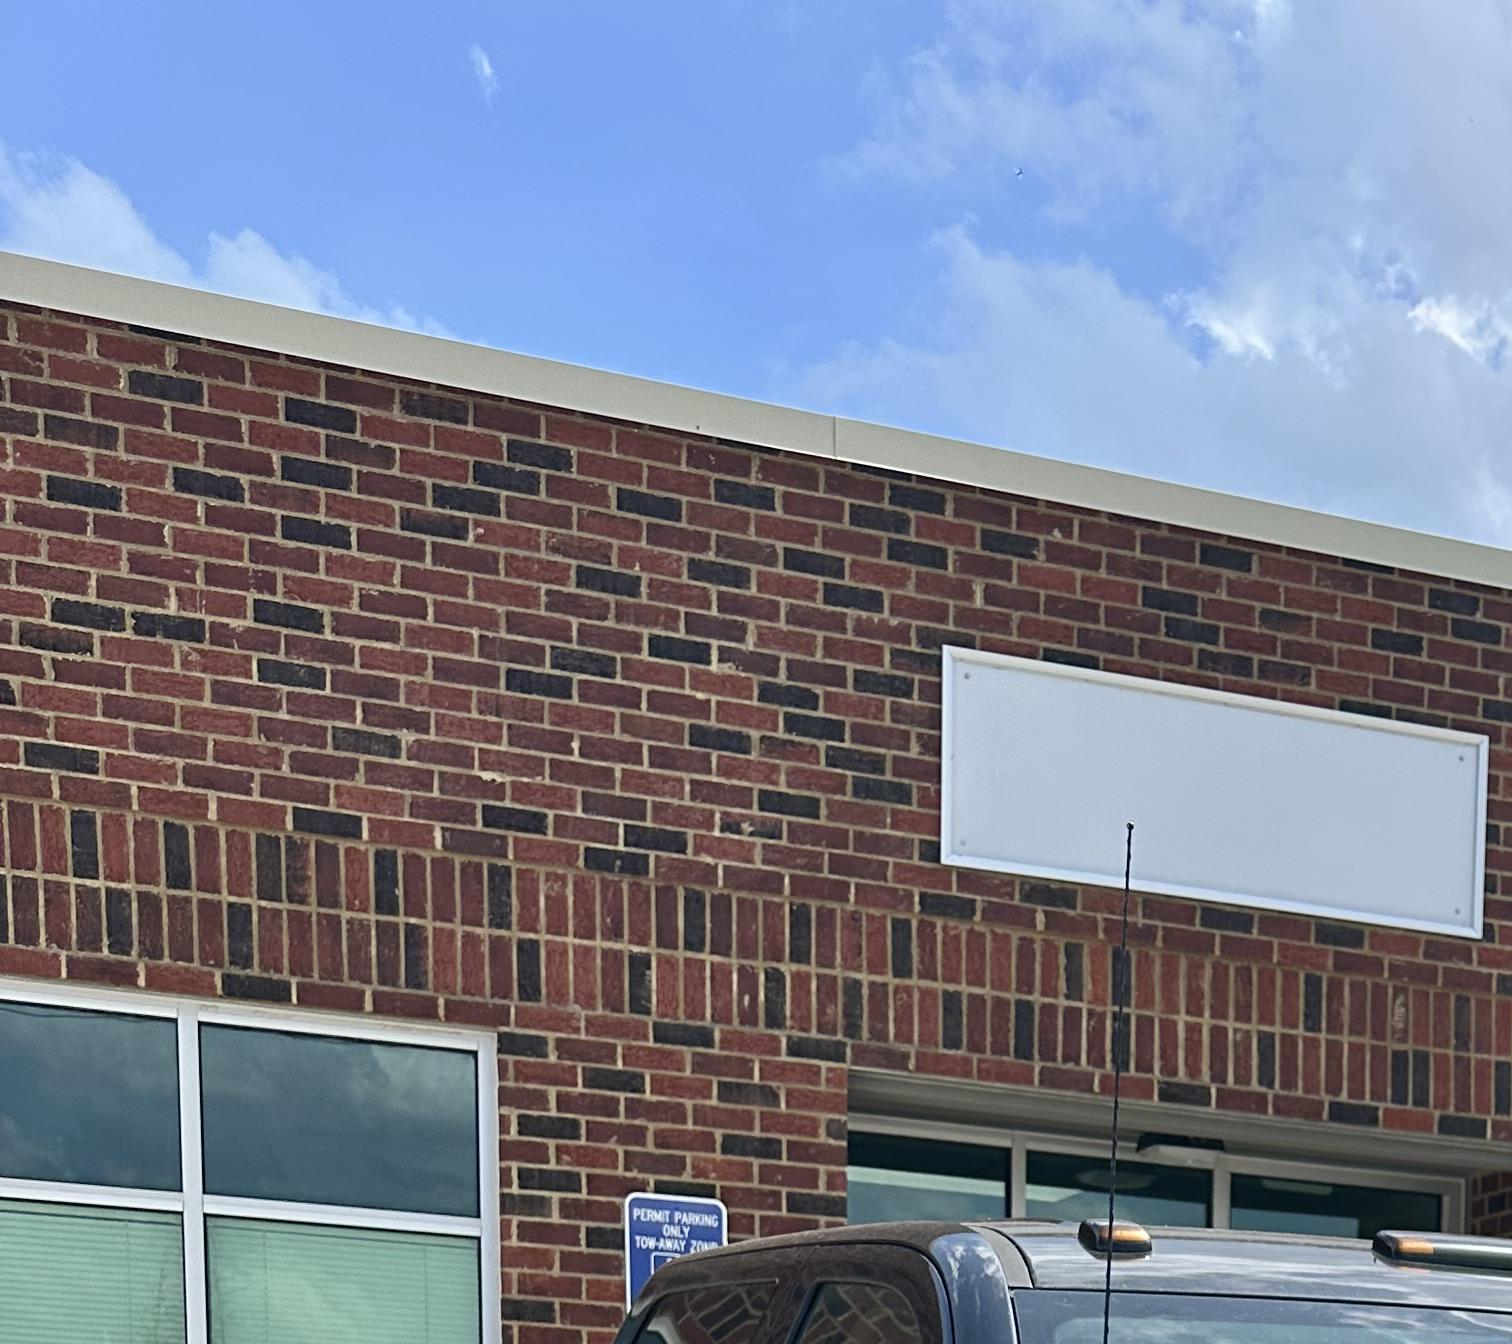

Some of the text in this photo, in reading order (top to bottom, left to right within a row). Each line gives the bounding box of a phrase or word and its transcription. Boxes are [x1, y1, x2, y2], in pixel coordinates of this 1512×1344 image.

[633, 1207, 719, 1227] PERMIT PARKING
[662, 1224, 691, 1238] ONLY
[634, 1235, 686, 1253] TOW-AWAY
